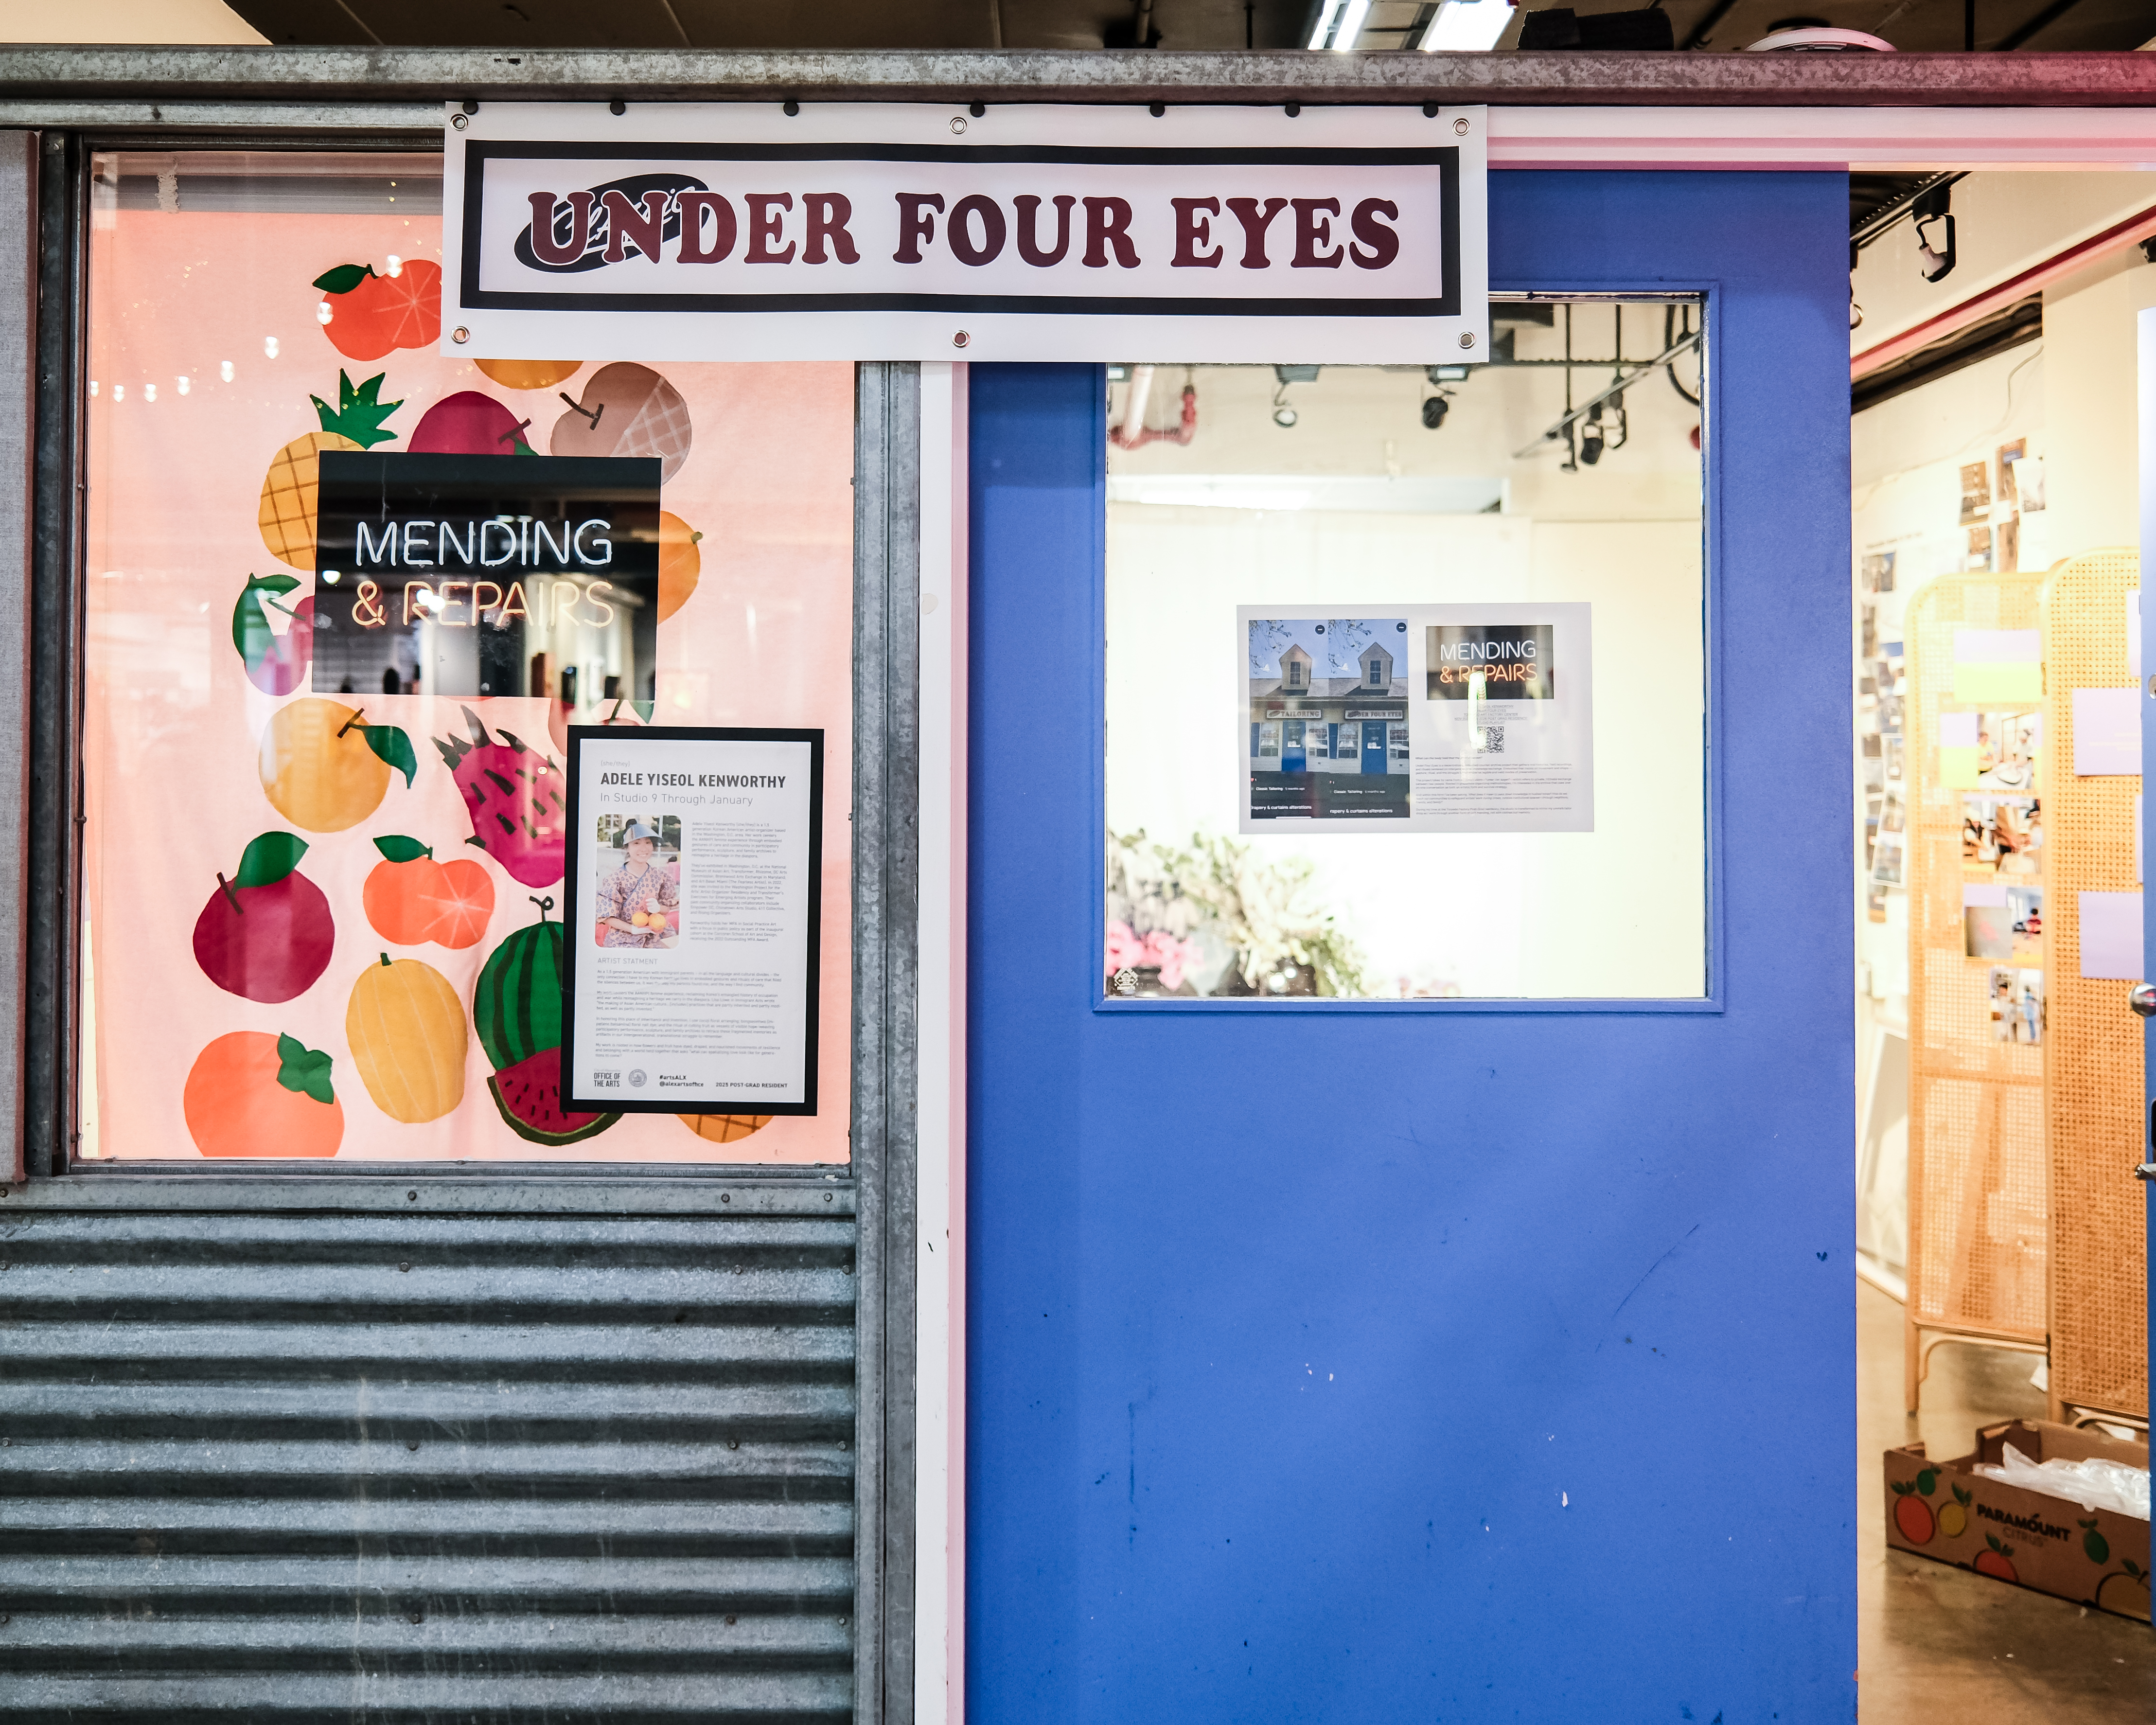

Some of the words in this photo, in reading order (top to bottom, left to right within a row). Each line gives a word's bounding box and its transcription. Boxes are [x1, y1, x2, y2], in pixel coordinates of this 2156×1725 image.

[528, 190, 860, 266] UNDER
[893, 192, 1141, 269] FOUR
[1170, 196, 1399, 270] EYES
[356, 519, 612, 566] MENDING
[352, 580, 386, 625] &
[403, 581, 615, 628] REPAIRS
[1440, 640, 1536, 661] MENDING
[1440, 665, 1453, 683] &
[601, 772, 643, 785] ADELE
[647, 773, 694, 787] YISEOL
[699, 774, 786, 788] KENWORTHY
[601, 793, 610, 802] In
[614, 793, 648, 803] Studio
[652, 794, 657, 803] 9
[661, 794, 706, 806] Through
[710, 795, 753, 807] January
